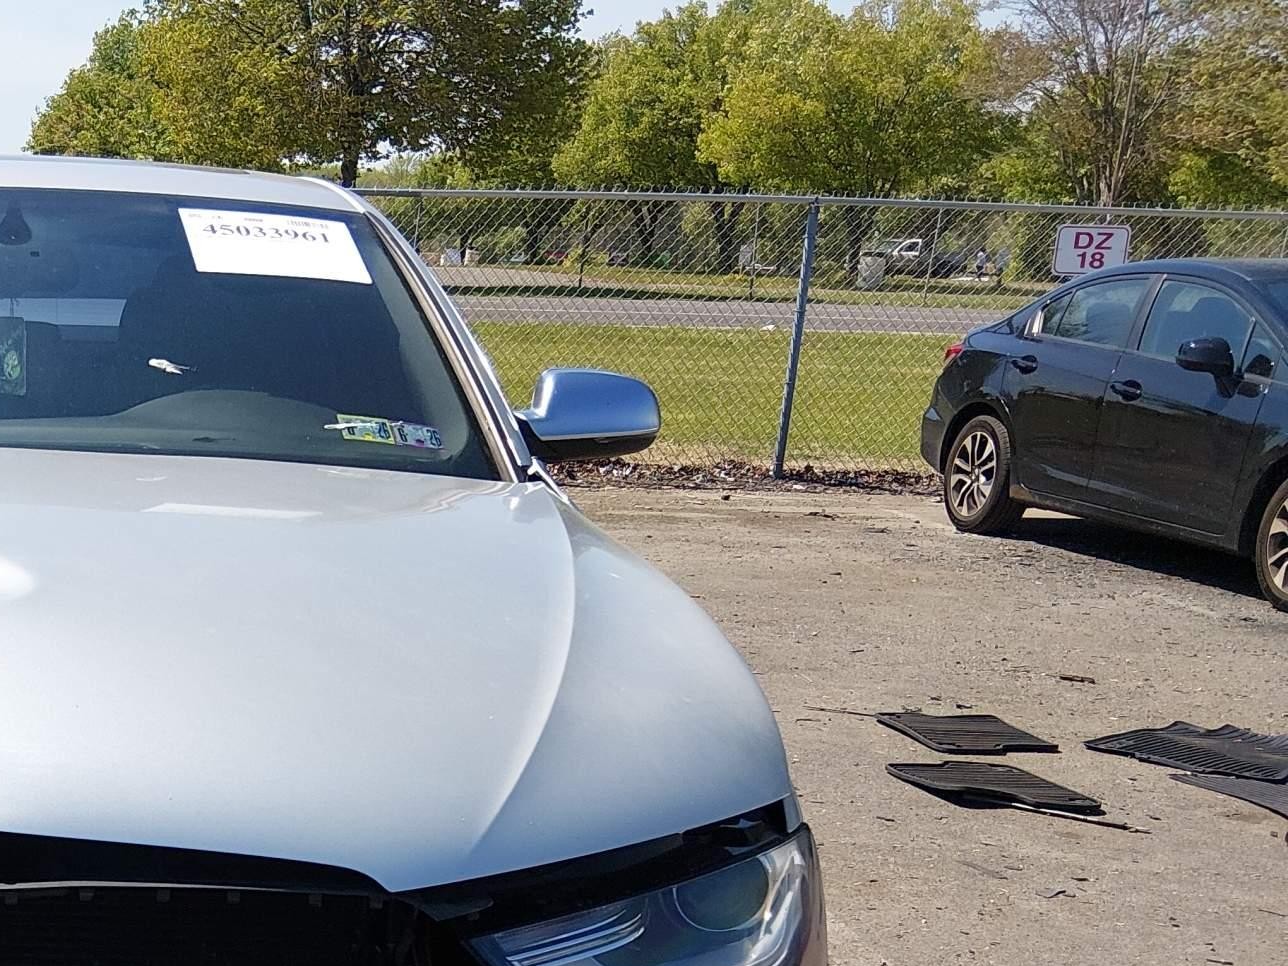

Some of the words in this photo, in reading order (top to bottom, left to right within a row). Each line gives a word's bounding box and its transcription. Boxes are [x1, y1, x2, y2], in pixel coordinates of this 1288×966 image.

[202, 223, 330, 244] 45033961
[1073, 231, 1114, 250] DZ
[1076, 251, 1105, 269] 18
